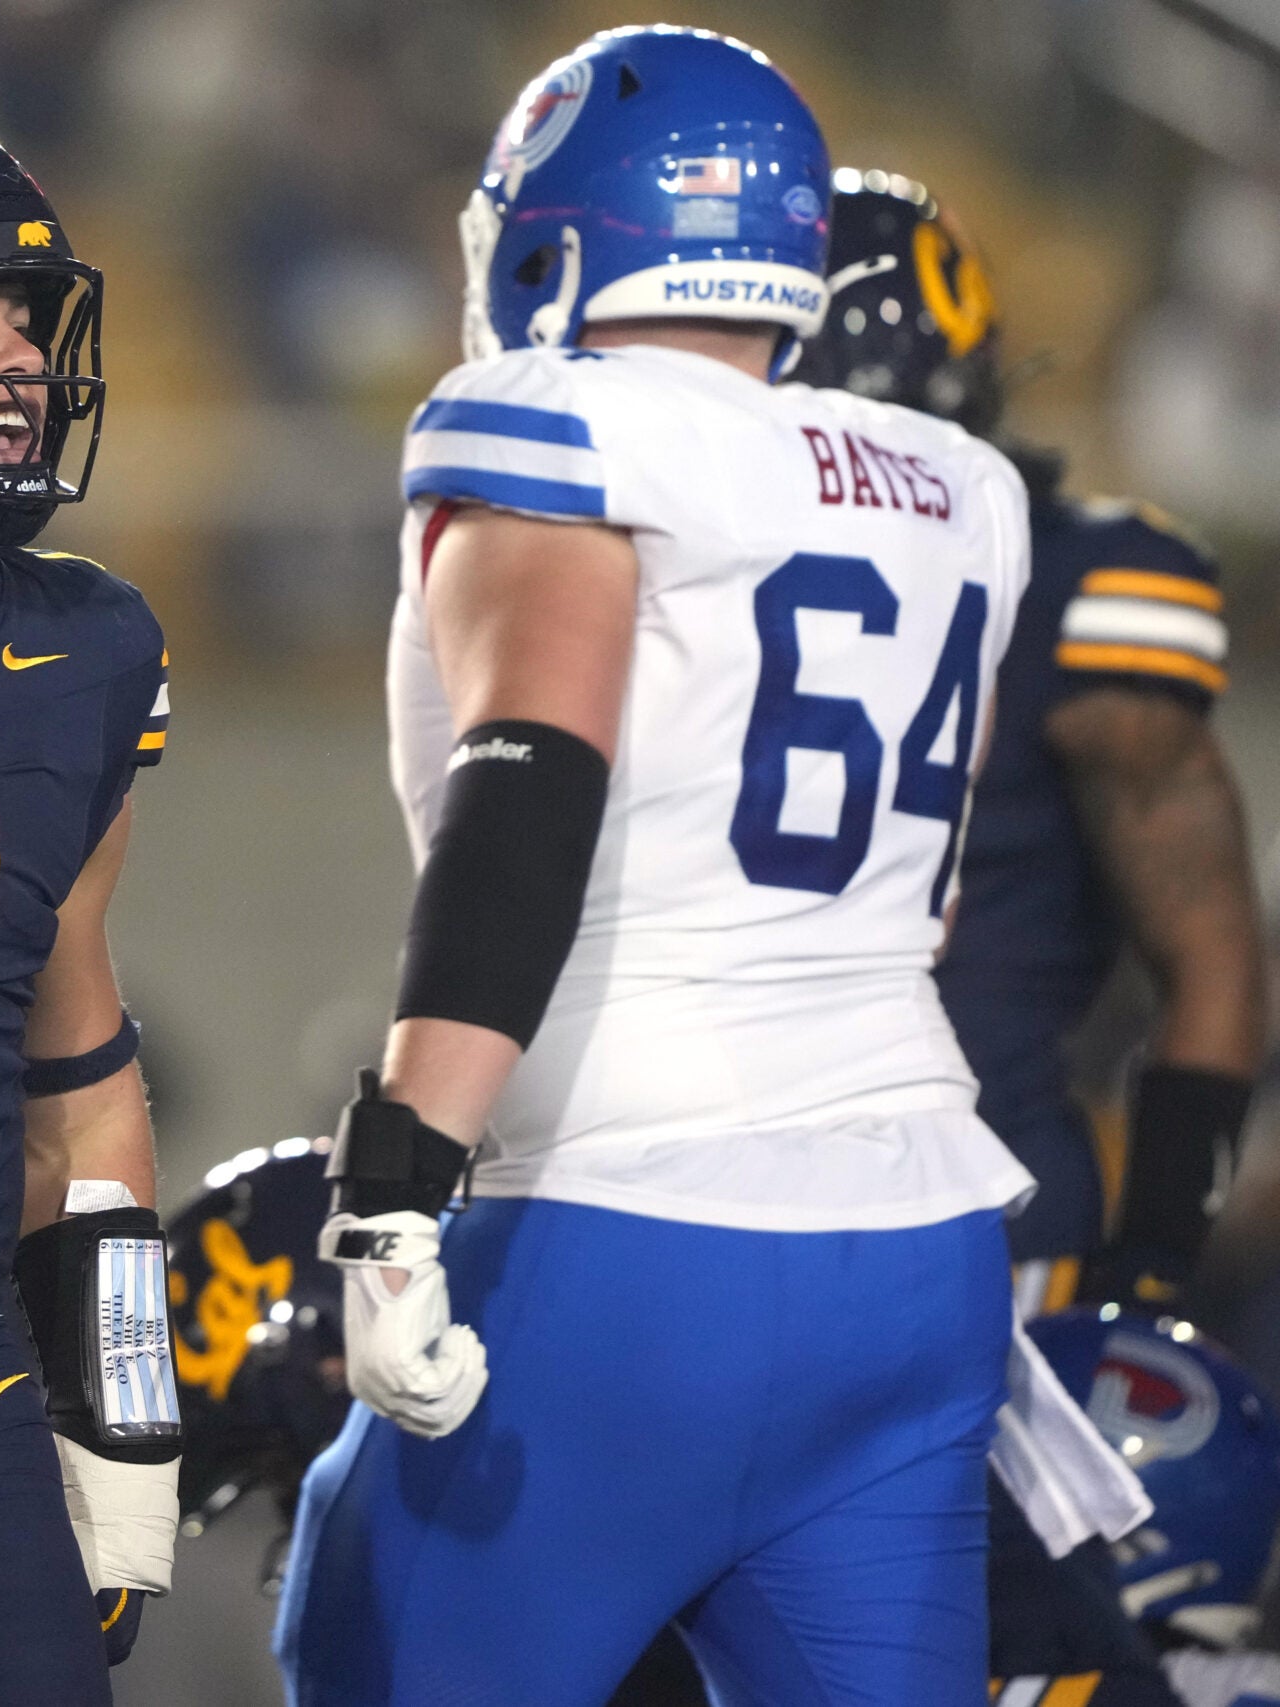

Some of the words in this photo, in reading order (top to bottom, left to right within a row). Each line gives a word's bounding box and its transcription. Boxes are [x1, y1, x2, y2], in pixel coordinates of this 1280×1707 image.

[663, 278, 822, 313] MUSTANGS
[800, 427, 950, 521] BATES
[729, 551, 988, 919] 64
[101, 1297, 112, 1332] TITE
[113, 1291, 123, 1327] TITE
[113, 1331, 129, 1385] FRSCO
[124, 1314, 136, 1364] WHIE
[134, 1319, 145, 1359] SARA
[155, 1317, 167, 1361] BAMA
